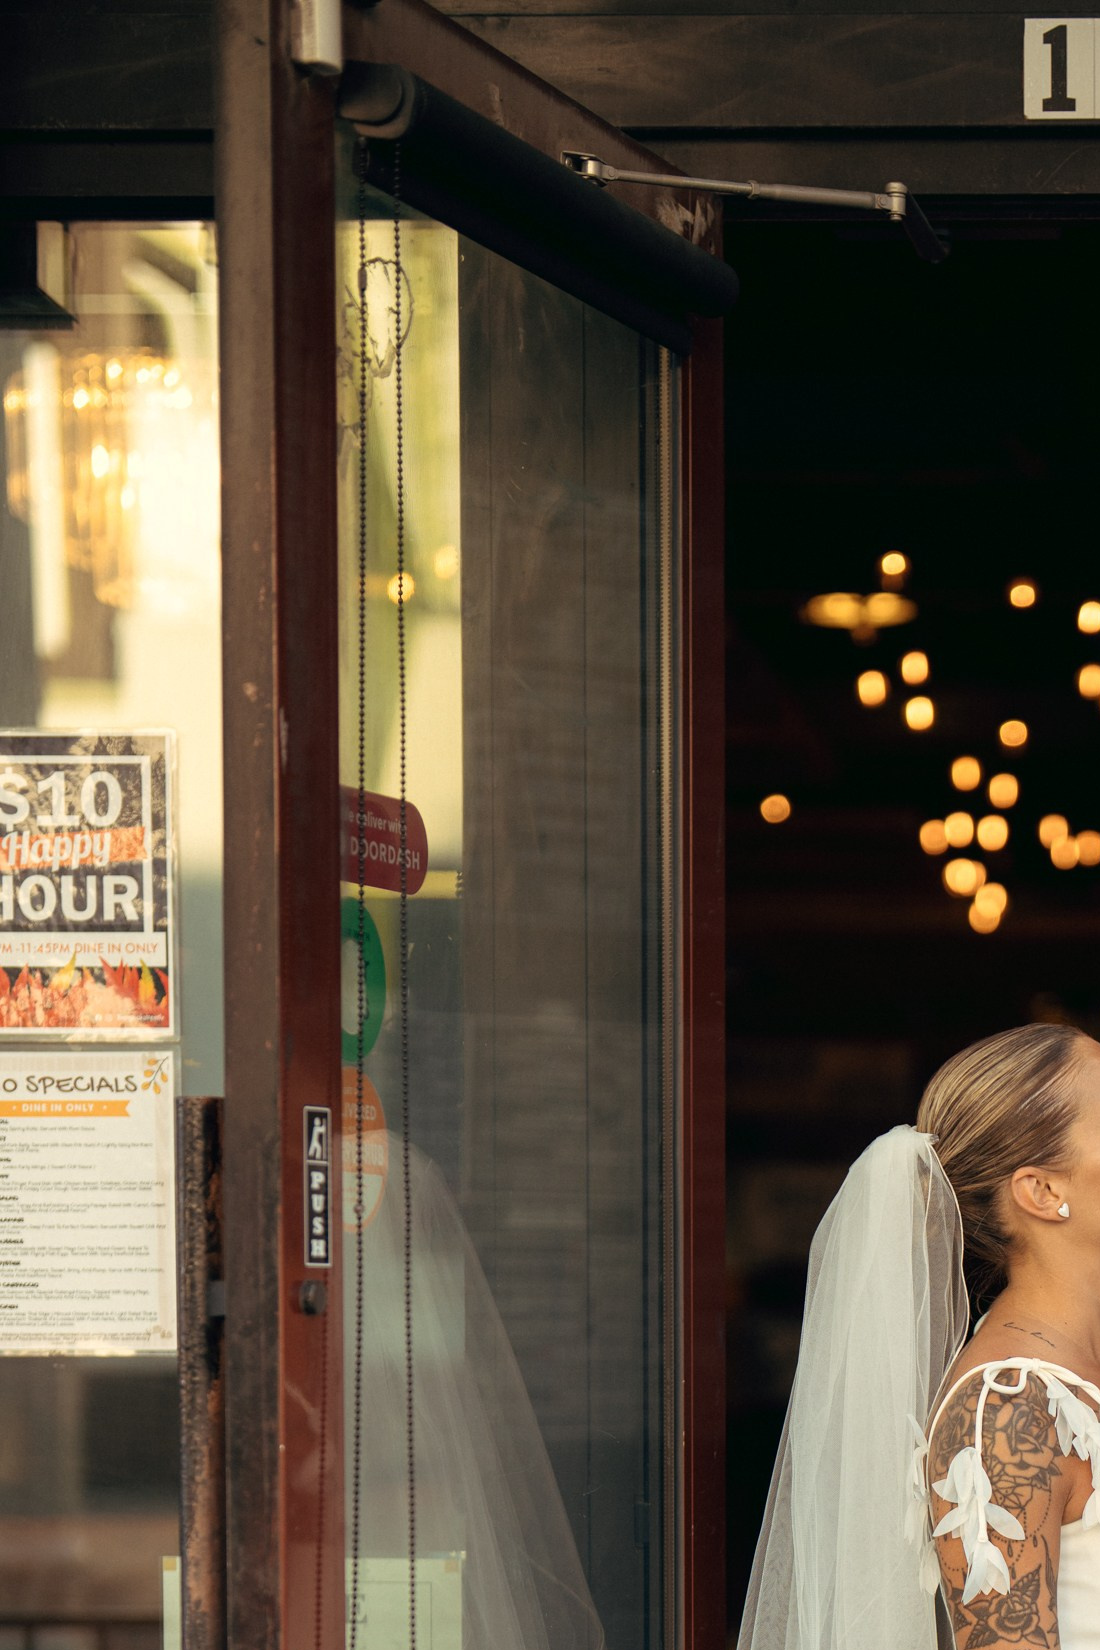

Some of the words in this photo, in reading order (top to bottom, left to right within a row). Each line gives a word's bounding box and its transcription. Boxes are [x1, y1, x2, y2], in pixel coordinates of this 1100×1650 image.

[1, 830, 112, 872] Happy
[75, 943, 104, 953] DINE
[108, 943, 121, 953] IN
[125, 942, 158, 953] ONLY
[26, 1075, 137, 1094] SPECIALS
[22, 1104, 48, 1112] DINE
[50, 1104, 62, 1112] IN
[66, 1103, 94, 1112] ONLY
[310, 1171, 327, 1258] PUSH
